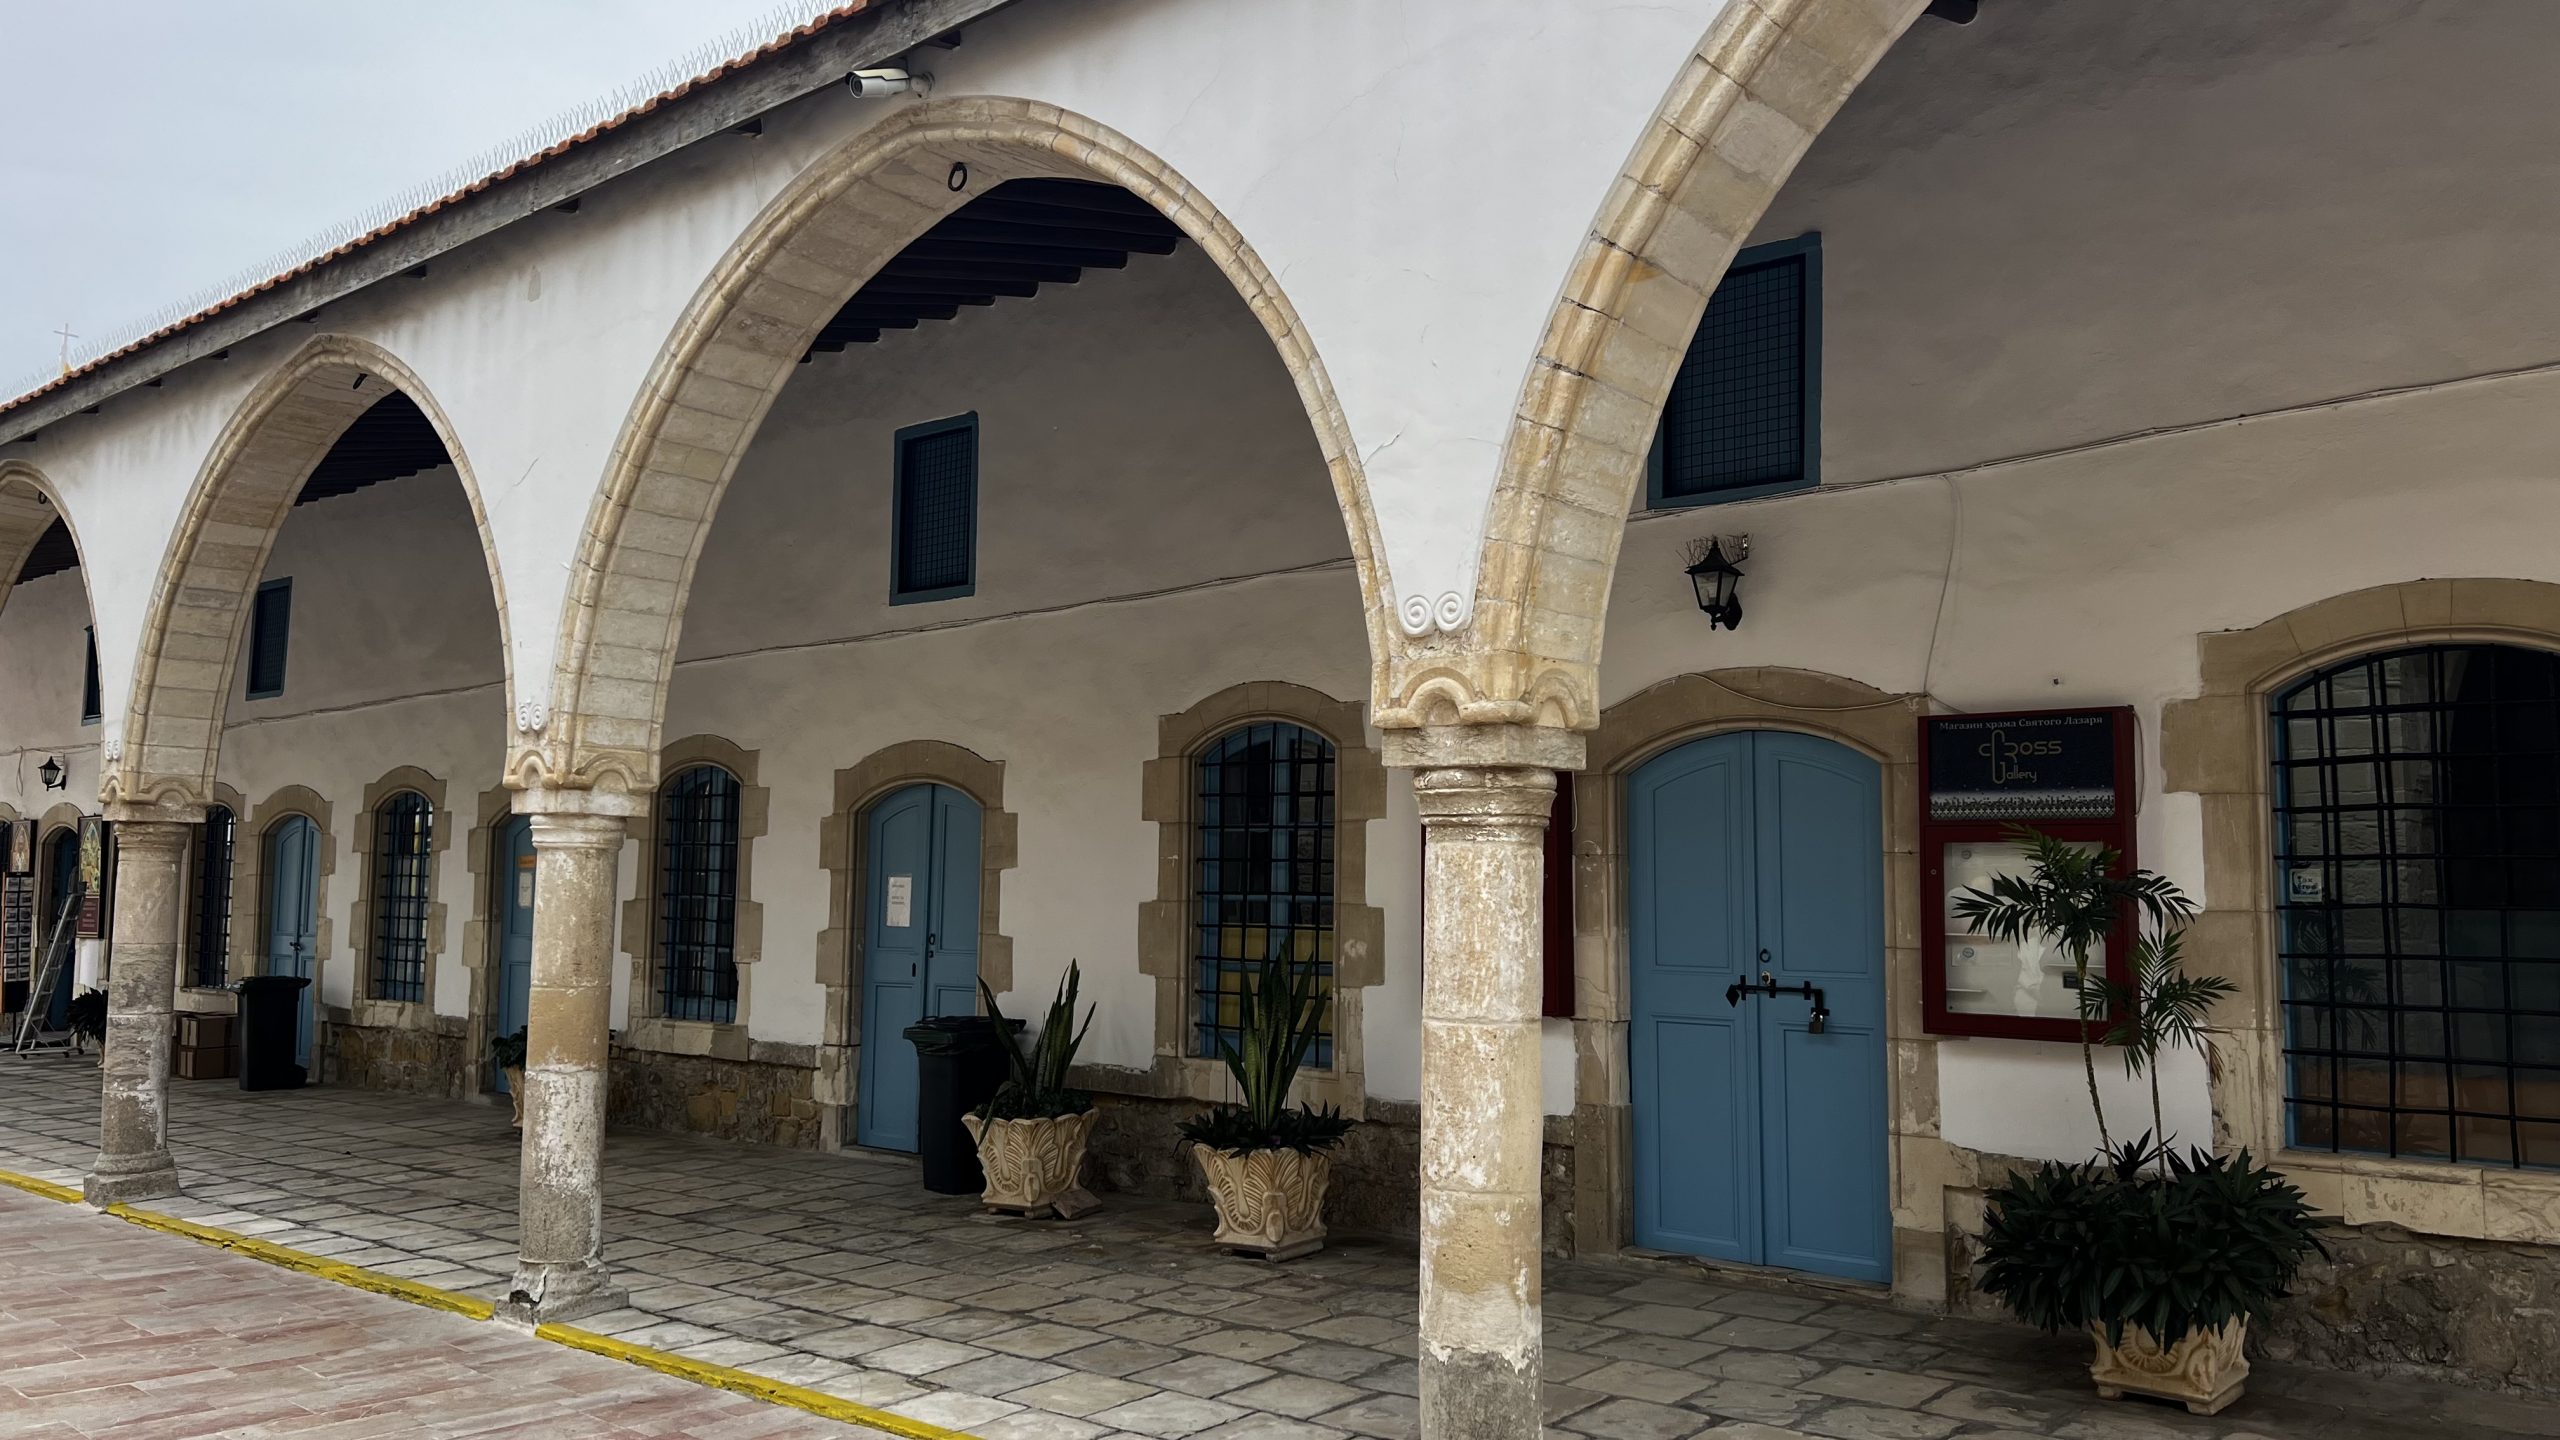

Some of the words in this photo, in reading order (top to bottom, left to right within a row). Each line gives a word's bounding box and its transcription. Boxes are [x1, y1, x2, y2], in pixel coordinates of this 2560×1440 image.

[1939, 721, 1983, 731] Магазин
[1985, 720, 2017, 730] храма
[2018, 717, 2062, 727] Святого
[2064, 715, 2103, 726] Лазаря
